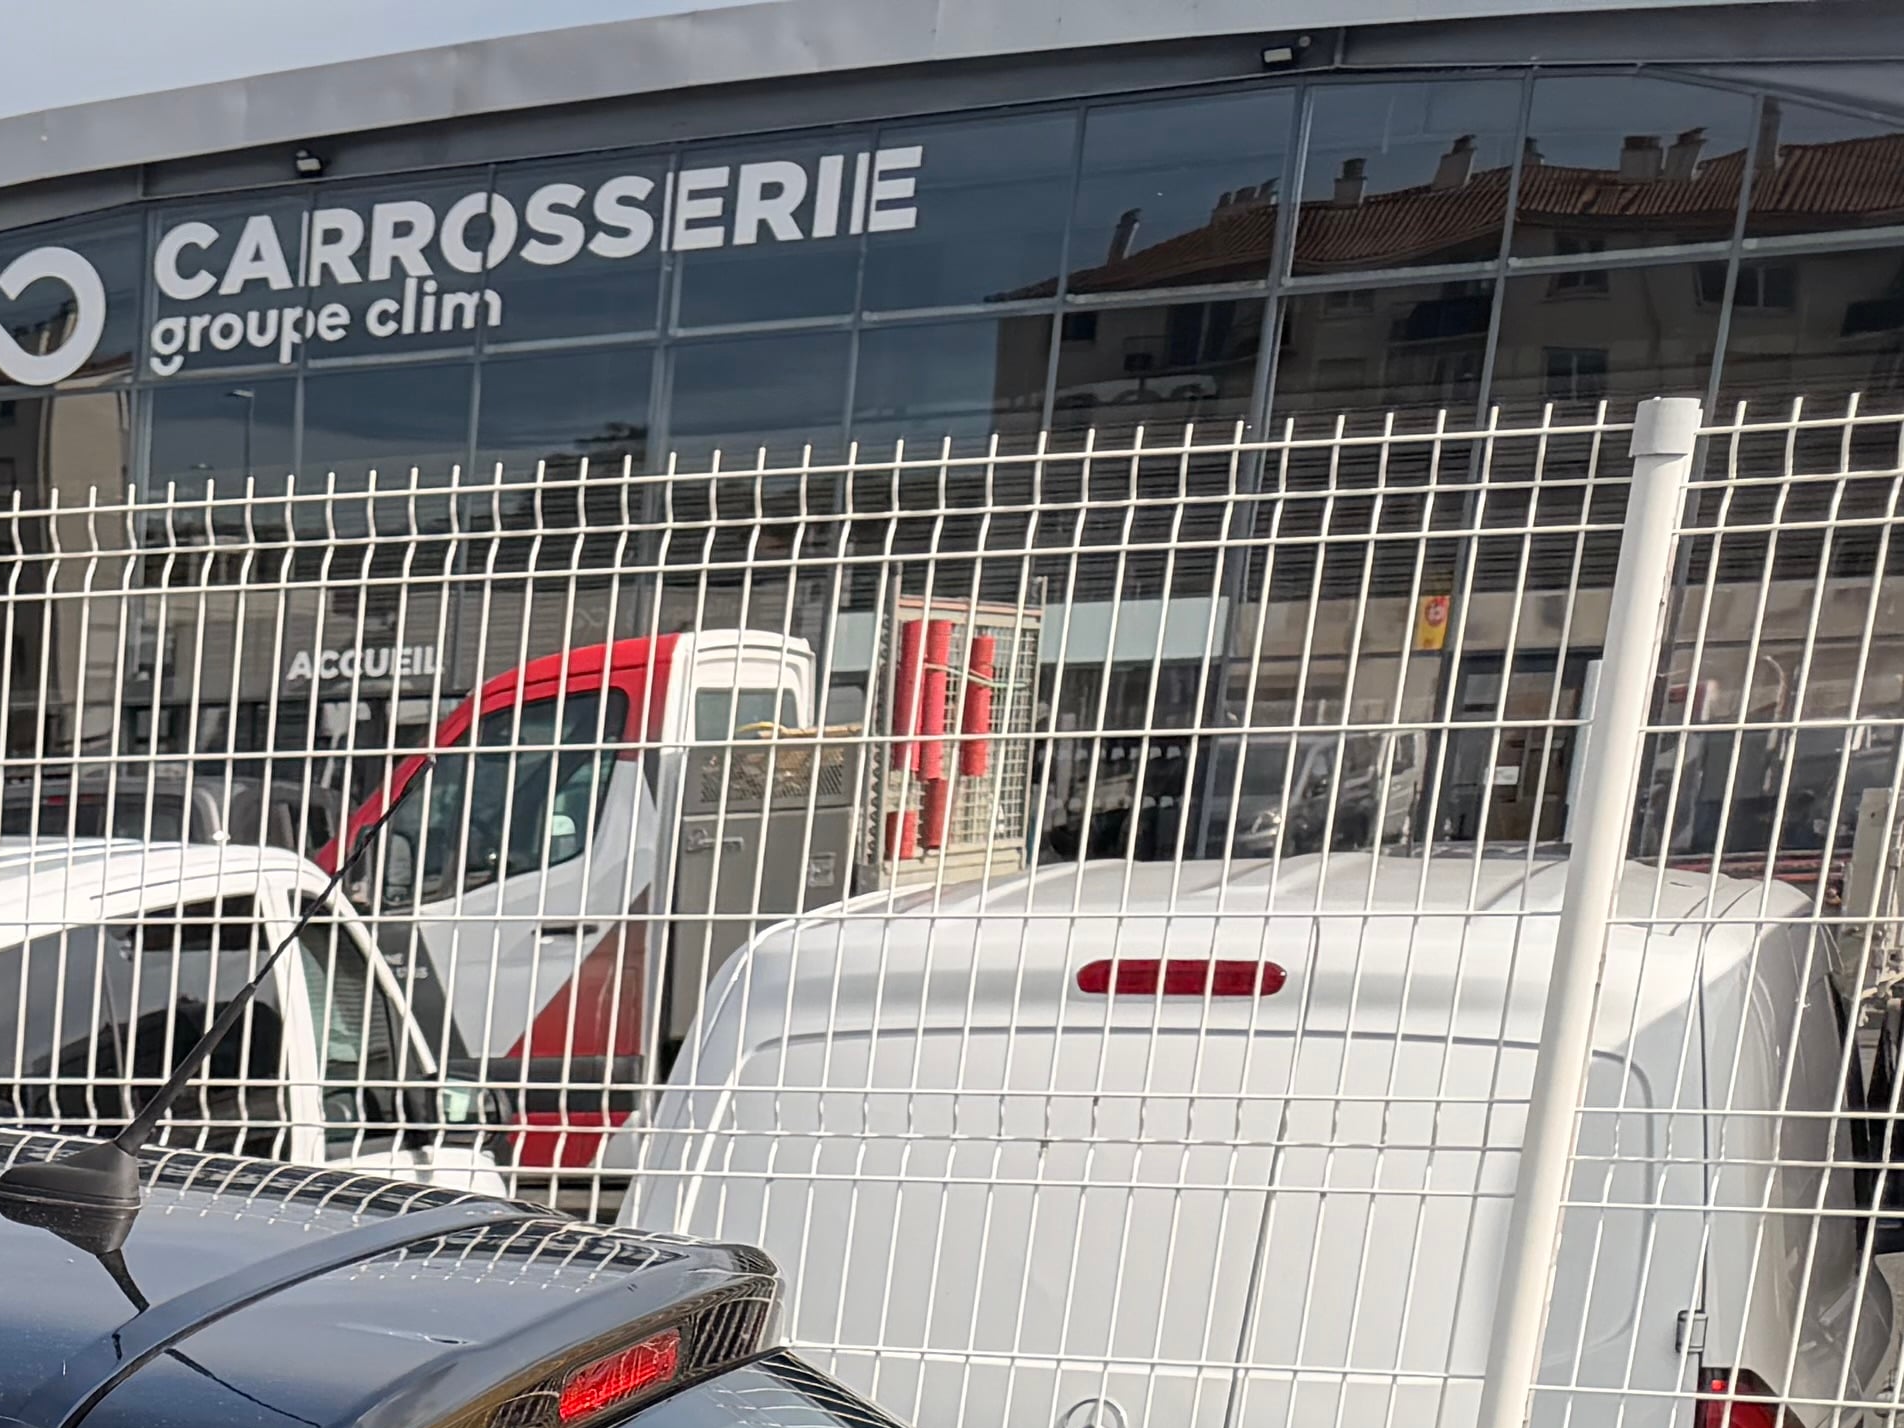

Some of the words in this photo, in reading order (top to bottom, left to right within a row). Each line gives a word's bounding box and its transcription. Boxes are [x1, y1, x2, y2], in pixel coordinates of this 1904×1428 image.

[154, 145, 923, 300] CARROSSERIE
[151, 301, 349, 376] groupe
[364, 274, 503, 340] clim
[286, 645, 444, 681] ACCUEIL
